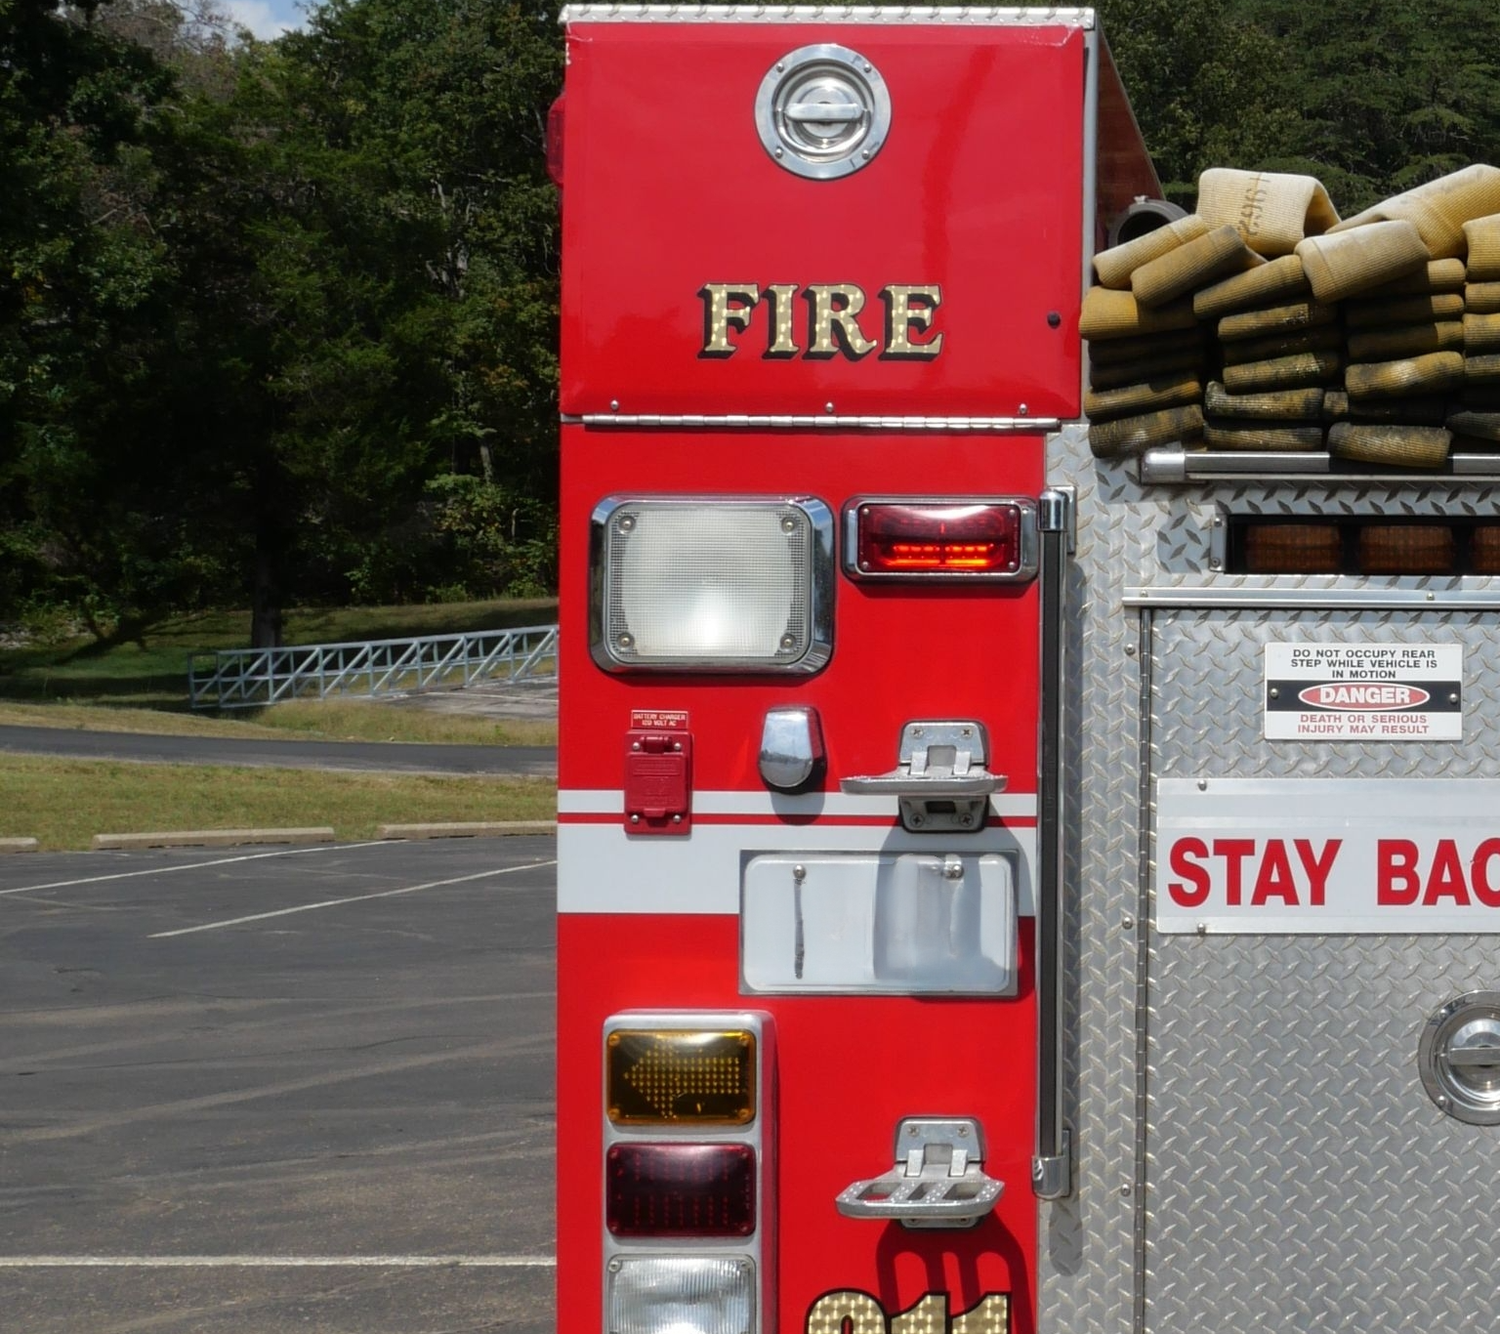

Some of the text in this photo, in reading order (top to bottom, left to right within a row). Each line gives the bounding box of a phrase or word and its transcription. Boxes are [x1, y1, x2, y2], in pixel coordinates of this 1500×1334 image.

[697, 282, 944, 362] FIRE
[1293, 649, 1436, 659] DO NOT OCCUPY REAR
[1291, 659, 1438, 668] STEP WHILE VEHICLE IS
[1332, 670, 1396, 679] IN MOTION
[1319, 687, 1411, 704] DANGER
[1300, 714, 1427, 724] DEATH OR SERIOUS
[1297, 724, 1430, 734] INJURY MAY RESULT
[1167, 837, 1343, 908] STAY
